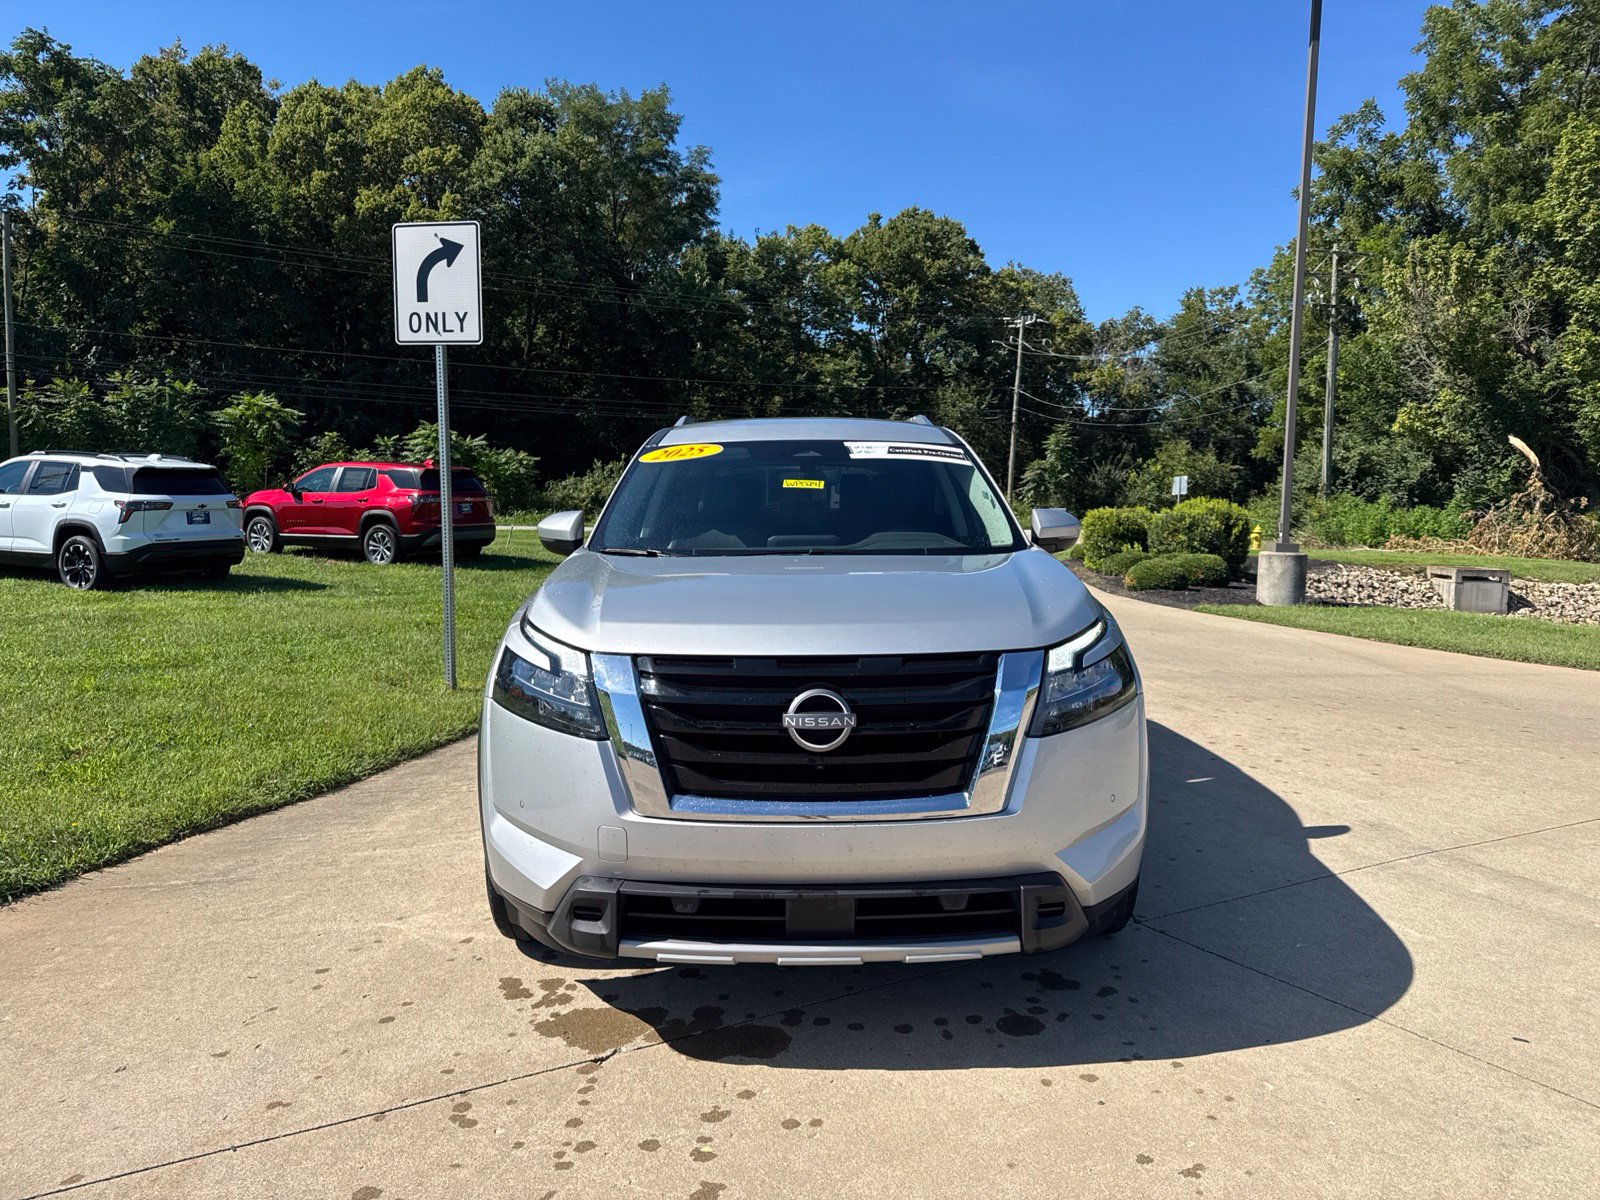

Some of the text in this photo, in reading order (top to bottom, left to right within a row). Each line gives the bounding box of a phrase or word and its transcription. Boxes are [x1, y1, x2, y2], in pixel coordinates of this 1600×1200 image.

[408, 311, 468, 334] ONLY
[650, 445, 711, 460] 2025
[889, 446, 923, 455] Certified
[923, 449, 964, 459] Pre-Owned
[784, 716, 856, 727] NISSAN
